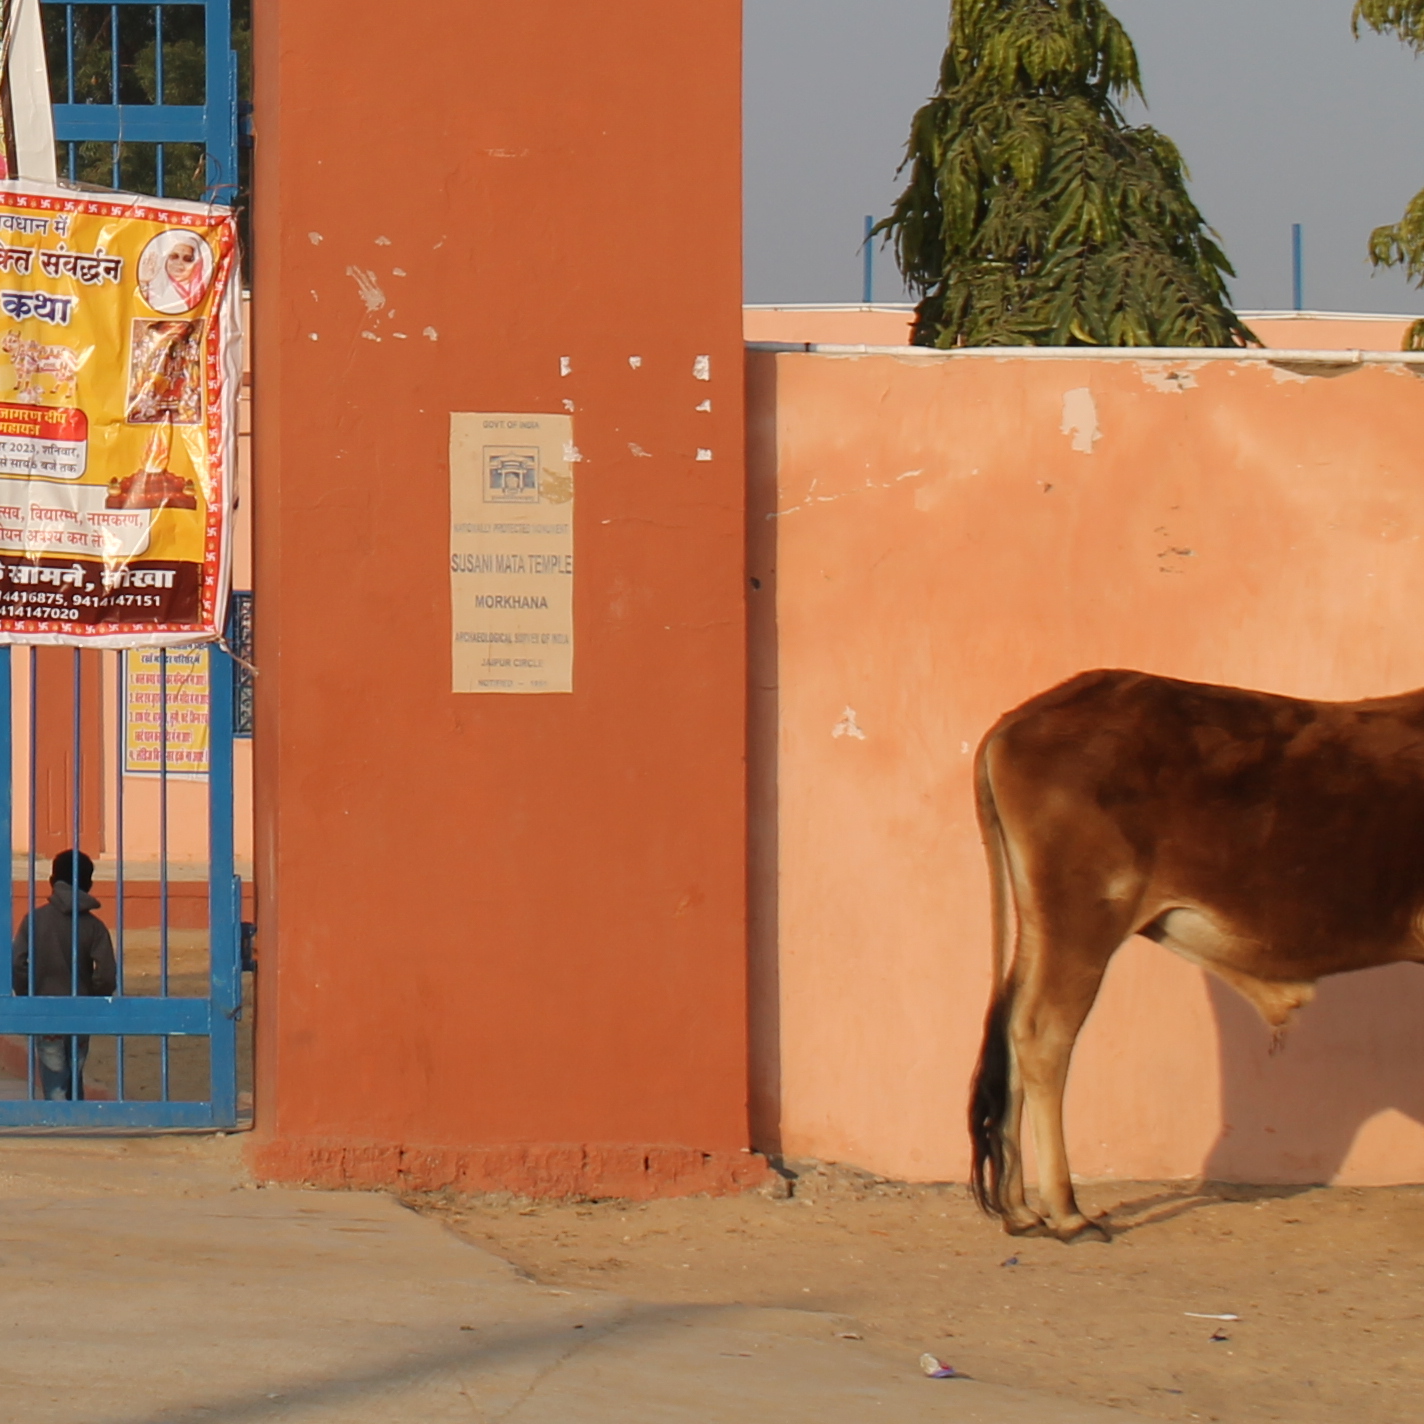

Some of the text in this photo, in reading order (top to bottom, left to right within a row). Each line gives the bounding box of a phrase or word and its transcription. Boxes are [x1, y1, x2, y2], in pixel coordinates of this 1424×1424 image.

[54, 214, 68, 237] में
[2, 290, 72, 324] कथा
[519, 421, 540, 429] INDIA
[87, 512, 143, 528] नामकरण,
[493, 523, 531, 534] PROTECTED
[67, 532, 88, 546] करा
[451, 553, 572, 575] SUSANI MATA TEMPLE
[475, 595, 548, 609] MORKHANA
[455, 632, 569, 644] ARCHAEOLOGICAL SURVEY OF INDIA
[481, 658, 543, 668] JAIPUR CIRCLE
